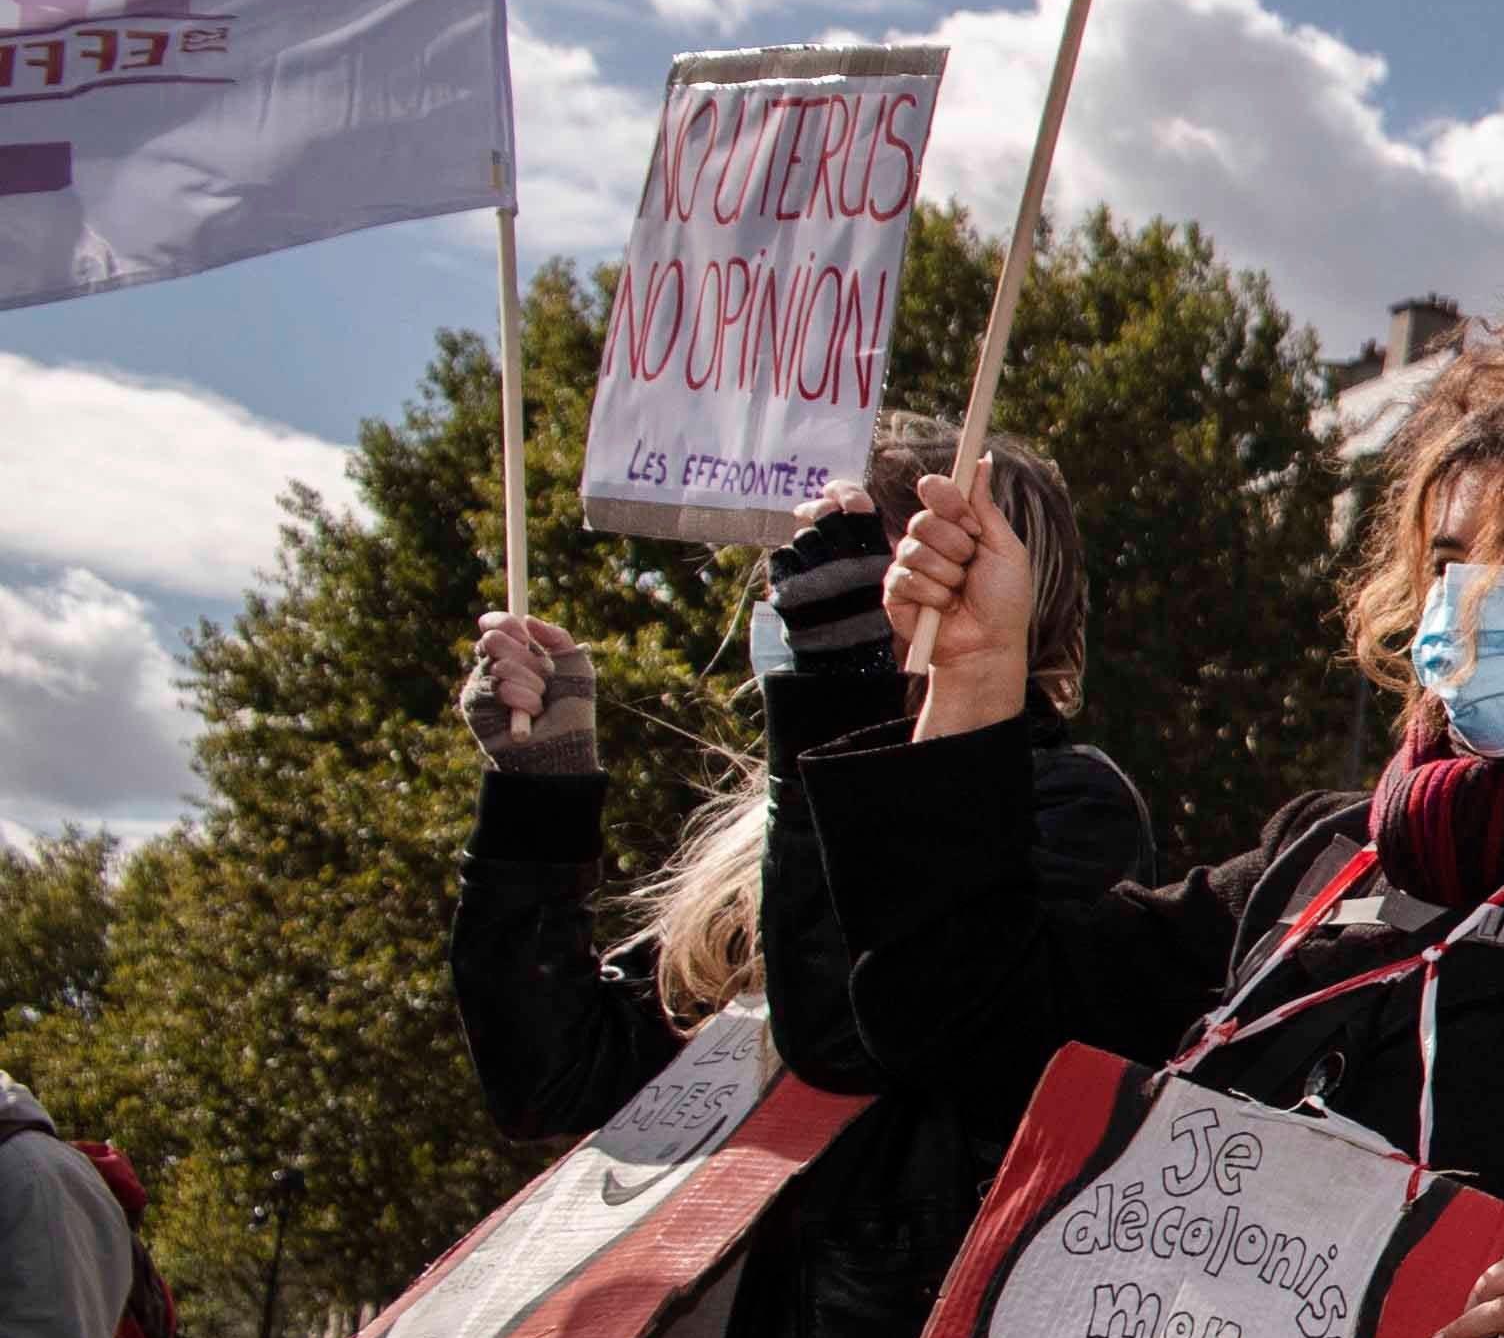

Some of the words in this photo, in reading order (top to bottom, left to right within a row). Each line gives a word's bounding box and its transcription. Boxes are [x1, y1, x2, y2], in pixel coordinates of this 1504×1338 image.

[661, 96, 719, 224] NO
[713, 93, 920, 225] UTERUS
[604, 260, 686, 382] NO
[627, 439, 667, 485] LES
[1162, 1107, 1263, 1197] Je
